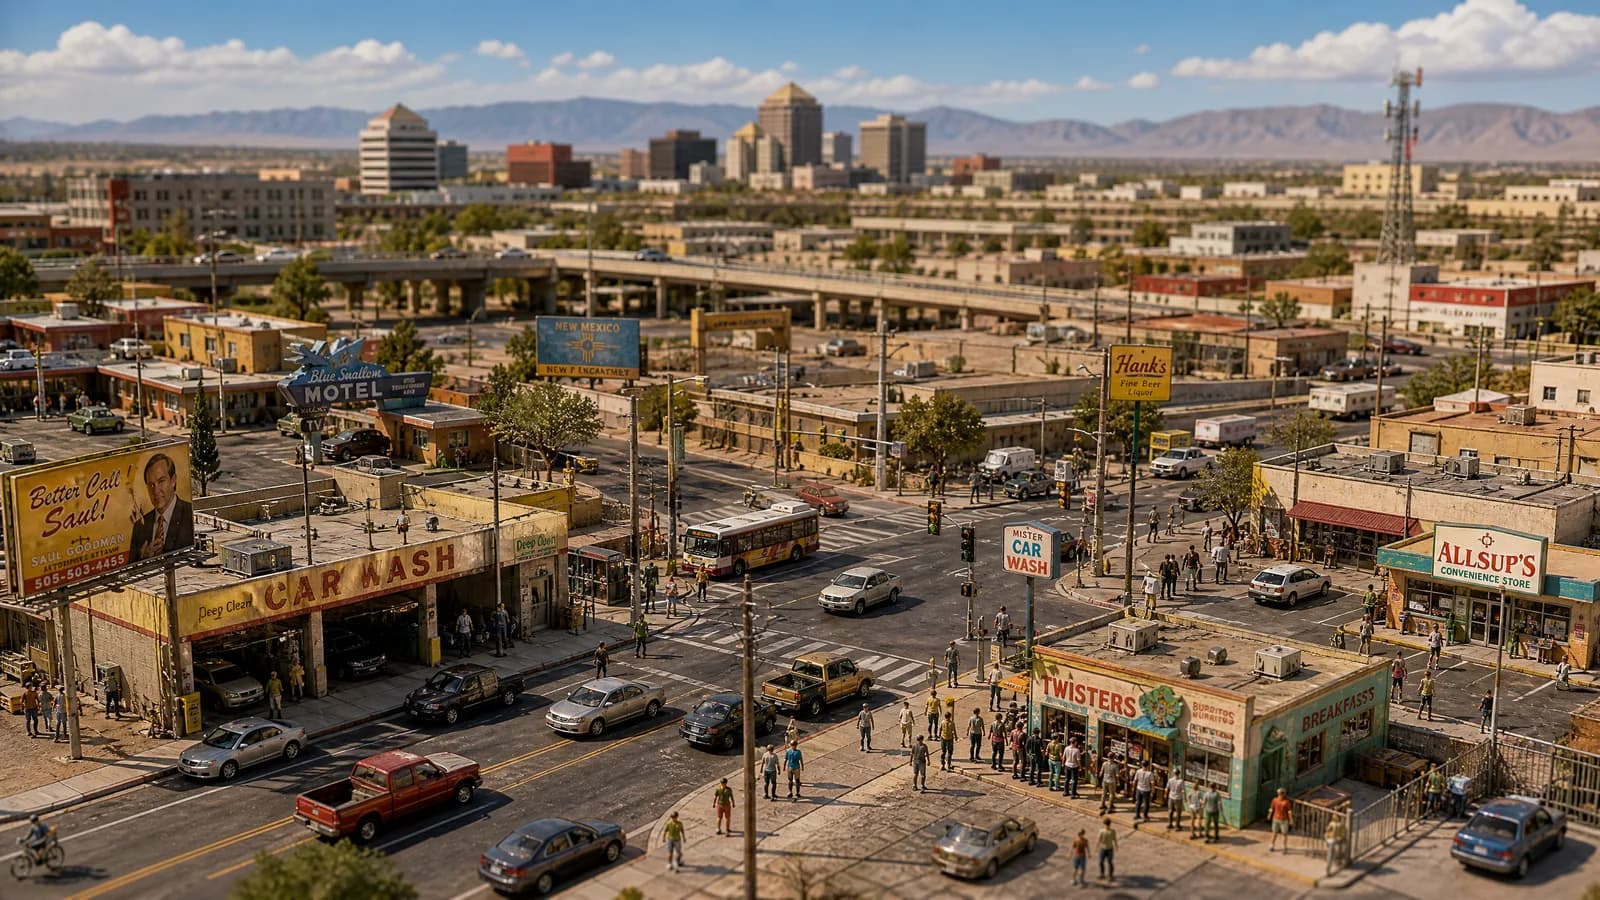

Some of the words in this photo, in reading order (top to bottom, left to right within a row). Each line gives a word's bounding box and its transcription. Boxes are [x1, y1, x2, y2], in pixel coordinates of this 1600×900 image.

[555, 321, 578, 331] NEW
[580, 322, 620, 333] MEXICO
[546, 366, 567, 374] NEW
[1115, 353, 1167, 374] Hank's
[307, 369, 336, 383] Blue
[304, 380, 383, 404] MOTEL
[29, 485, 80, 510] Better
[85, 469, 121, 499] Call
[42, 493, 111, 538] Saul!
[1012, 529, 1043, 542] MISTER
[31, 550, 63, 567] SAUL
[66, 534, 125, 556] GOODMAN
[1012, 539, 1042, 558] CAR
[1436, 541, 1536, 578] ALLSUP'S
[34, 554, 126, 590] 505-503-4455
[1007, 555, 1048, 575] WASH
[264, 569, 342, 611] CAR
[361, 543, 455, 589] WASH
[1440, 566, 1500, 583] CONVENIENCE
[1502, 576, 1531, 589] STORE
[1043, 675, 1137, 718] TWISTERS
